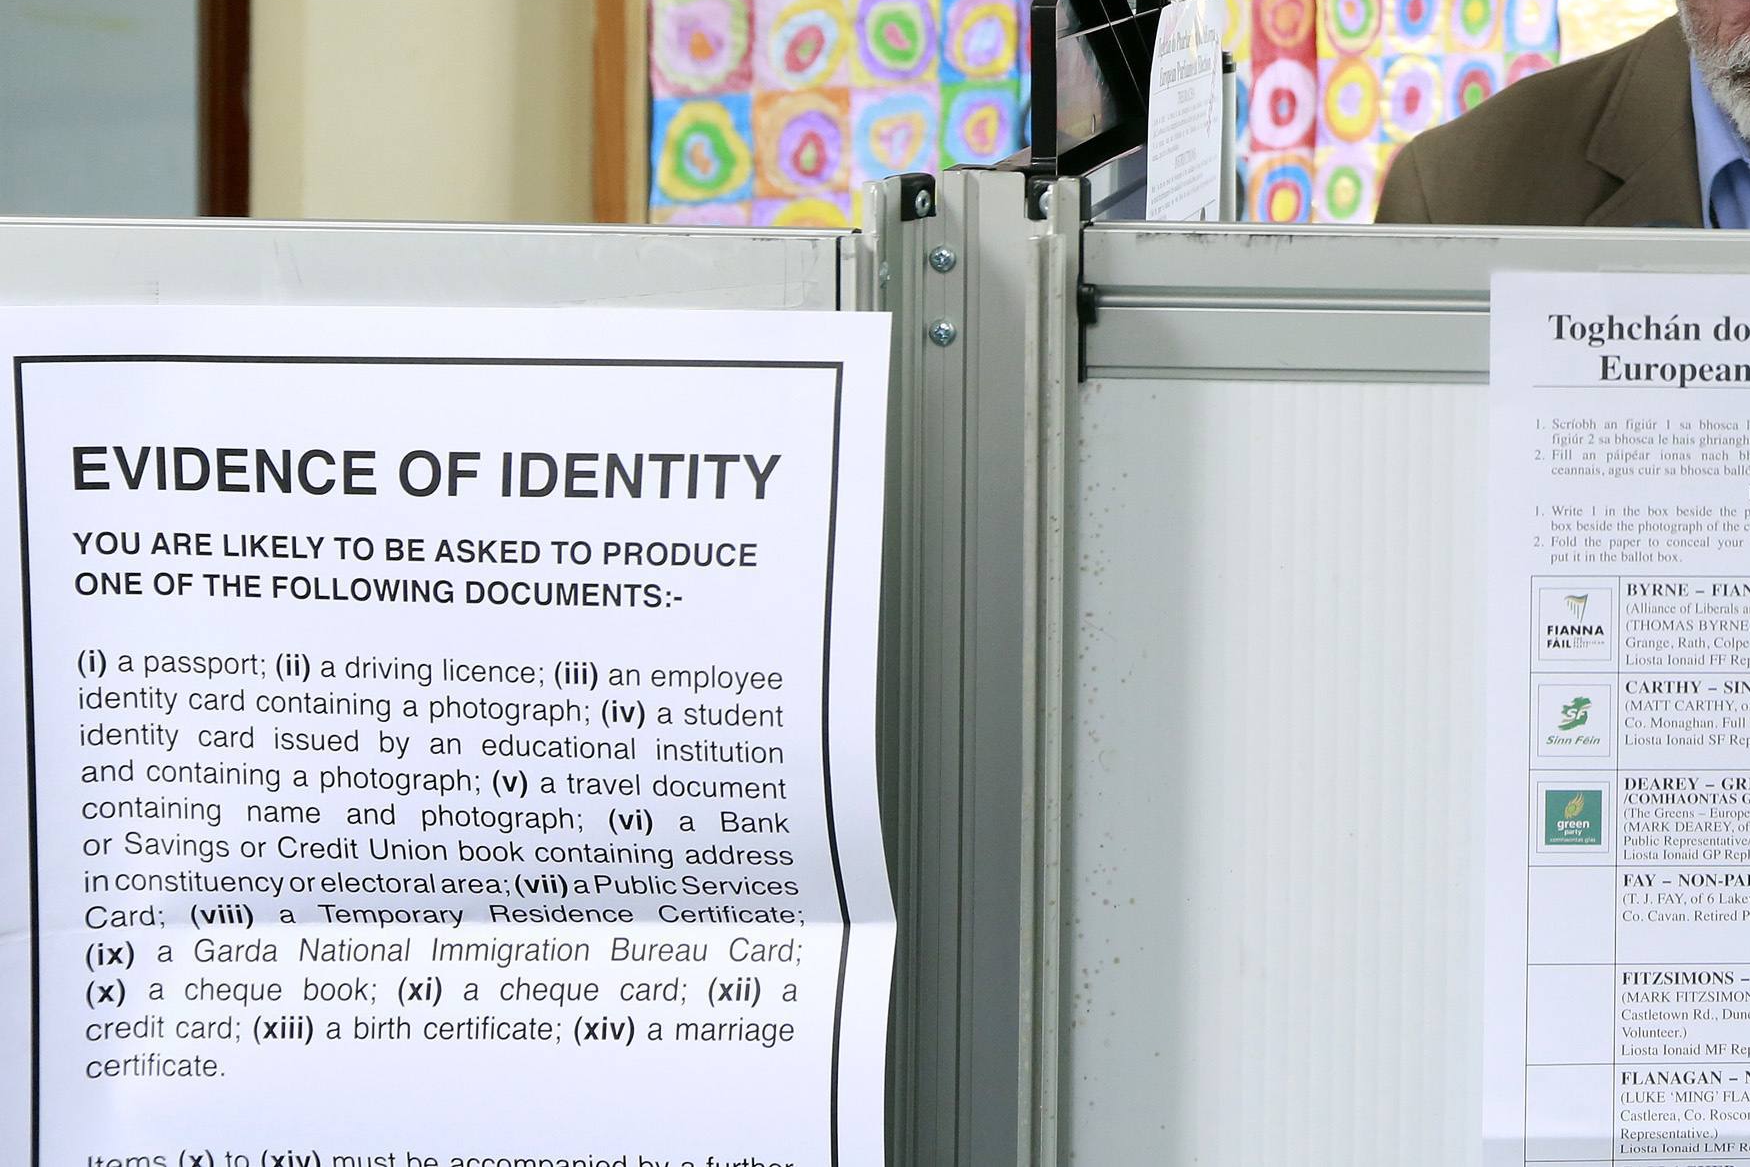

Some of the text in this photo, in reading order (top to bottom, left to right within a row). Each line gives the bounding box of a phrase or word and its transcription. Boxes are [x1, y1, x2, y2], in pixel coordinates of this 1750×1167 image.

[1547, 313, 1701, 348] Toghchán
[1712, 314, 1750, 342] do
[72, 445, 782, 500] EVIDENCE OF IDENTITY
[1607, 466, 1635, 478] agus
[1637, 463, 1661, 476] cuir
[1663, 466, 1676, 476] sa
[1679, 463, 1720, 476] bhosca
[1550, 519, 1572, 532] box
[1575, 519, 1613, 532] beside
[1615, 519, 1634, 532] the
[1637, 519, 1703, 535] photograph
[1705, 519, 1720, 532] of
[1721, 519, 1740, 532] the
[71, 530, 758, 568] YOU ARE LIKELY TO BE ASKED TO PRODUCE
[73, 571, 683, 609] ONE OF THE FOLLOWING DOCUMENTS:-
[1626, 582, 1689, 597] BYRNE
[1546, 625, 1605, 636] FIANNA
[1624, 618, 1694, 635] (THOMAS
[1546, 637, 1572, 649] FÁIL
[76, 648, 783, 696] (i) a passport; (ii) a driving licence; (iii) an employee
[1624, 679, 1702, 694] CARTHY
[1624, 698, 1671, 713] (MATT
[1565, 708, 1587, 720] SF
[1721, 715, 1746, 729] Full
[79, 721, 784, 764] identity card issued by an educational institution
[1546, 735, 1572, 745] Sinn
[1624, 776, 1699, 791] DEAREY
[1622, 792, 1737, 805] /COMHAONTAS
[1556, 819, 1590, 832] green
[82, 830, 794, 870] or Savings or Credit Union book containing address
[1623, 873, 1656, 887] FAY
[84, 936, 803, 972] (ix) a Garda National Immigration Bureau Card;
[1621, 970, 1734, 985] FITZSIMONS
[1620, 1007, 1689, 1021] Castletown
[84, 1013, 795, 1049] credit card; (xiii) a birth certificate; (xiv) a marriage
[1621, 1069, 1722, 1085] FLANAGAN
